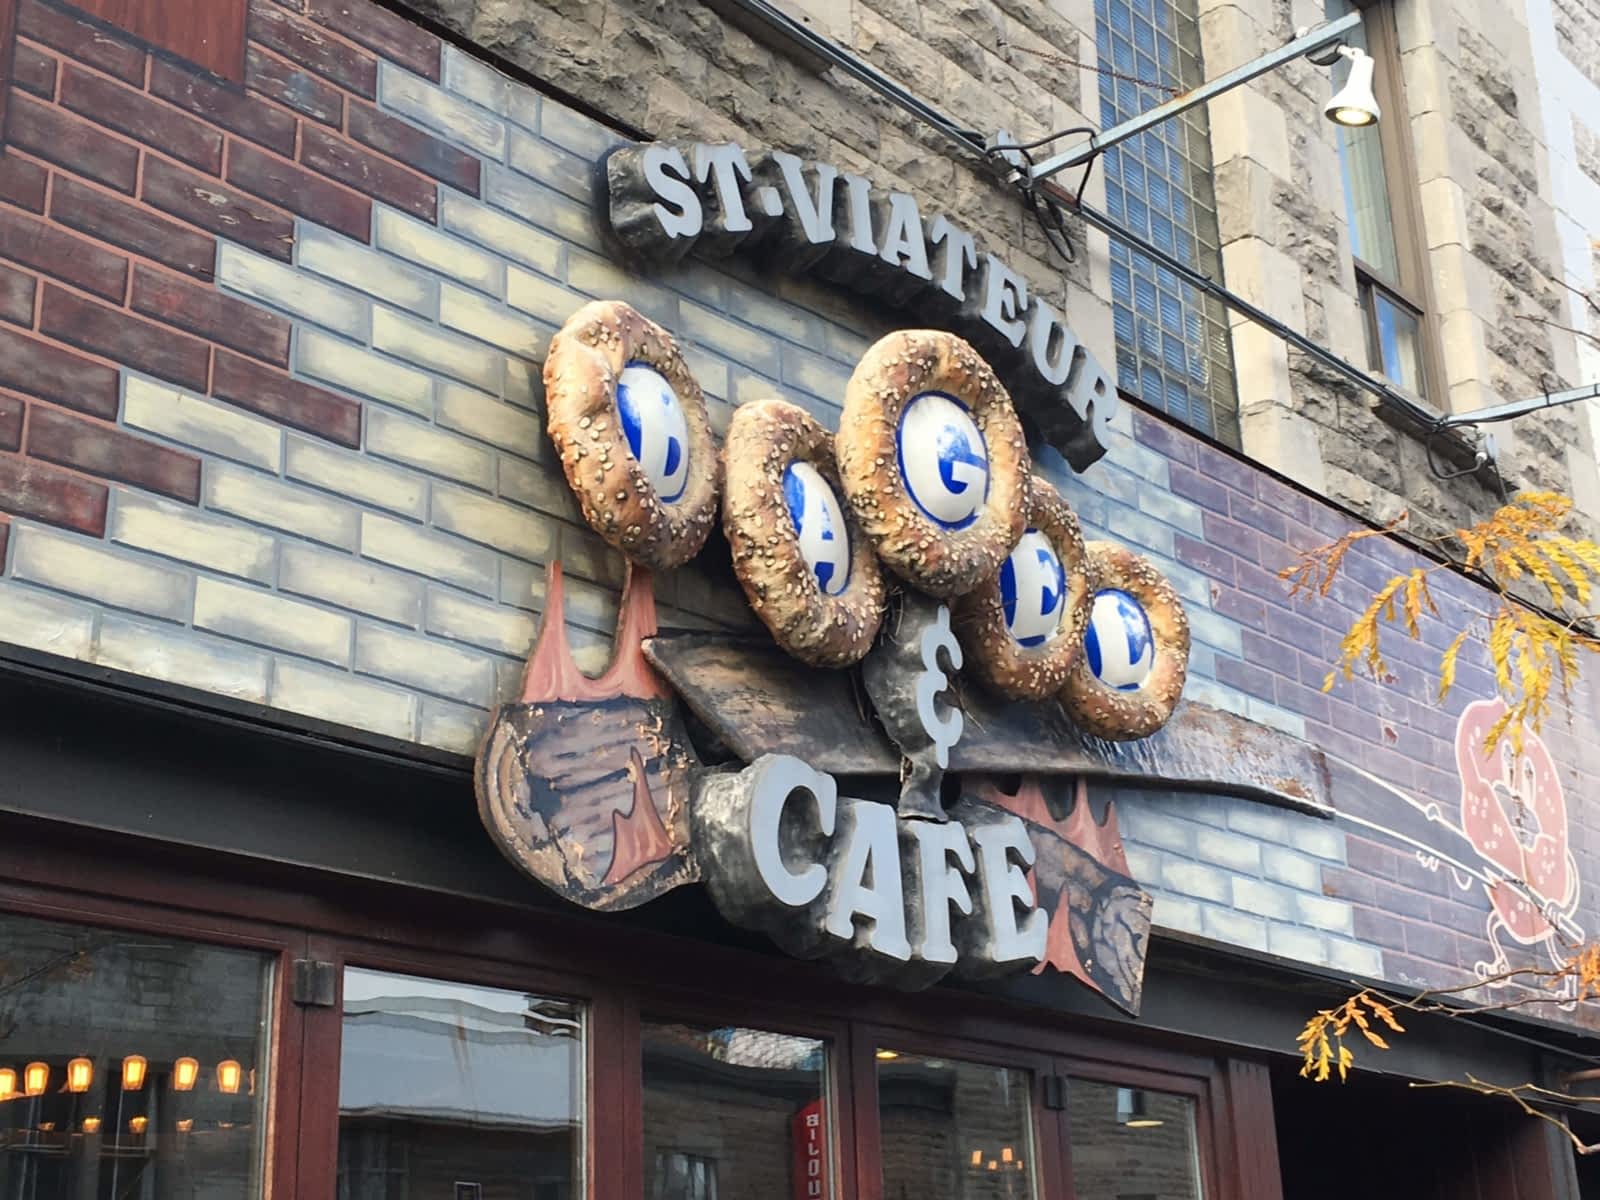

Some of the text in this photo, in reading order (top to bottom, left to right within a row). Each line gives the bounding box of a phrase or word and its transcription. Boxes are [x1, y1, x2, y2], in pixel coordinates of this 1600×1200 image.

[617, 362, 1156, 690] BAGEL
[917, 604, 964, 769] &
[750, 753, 1049, 963] CAFE
